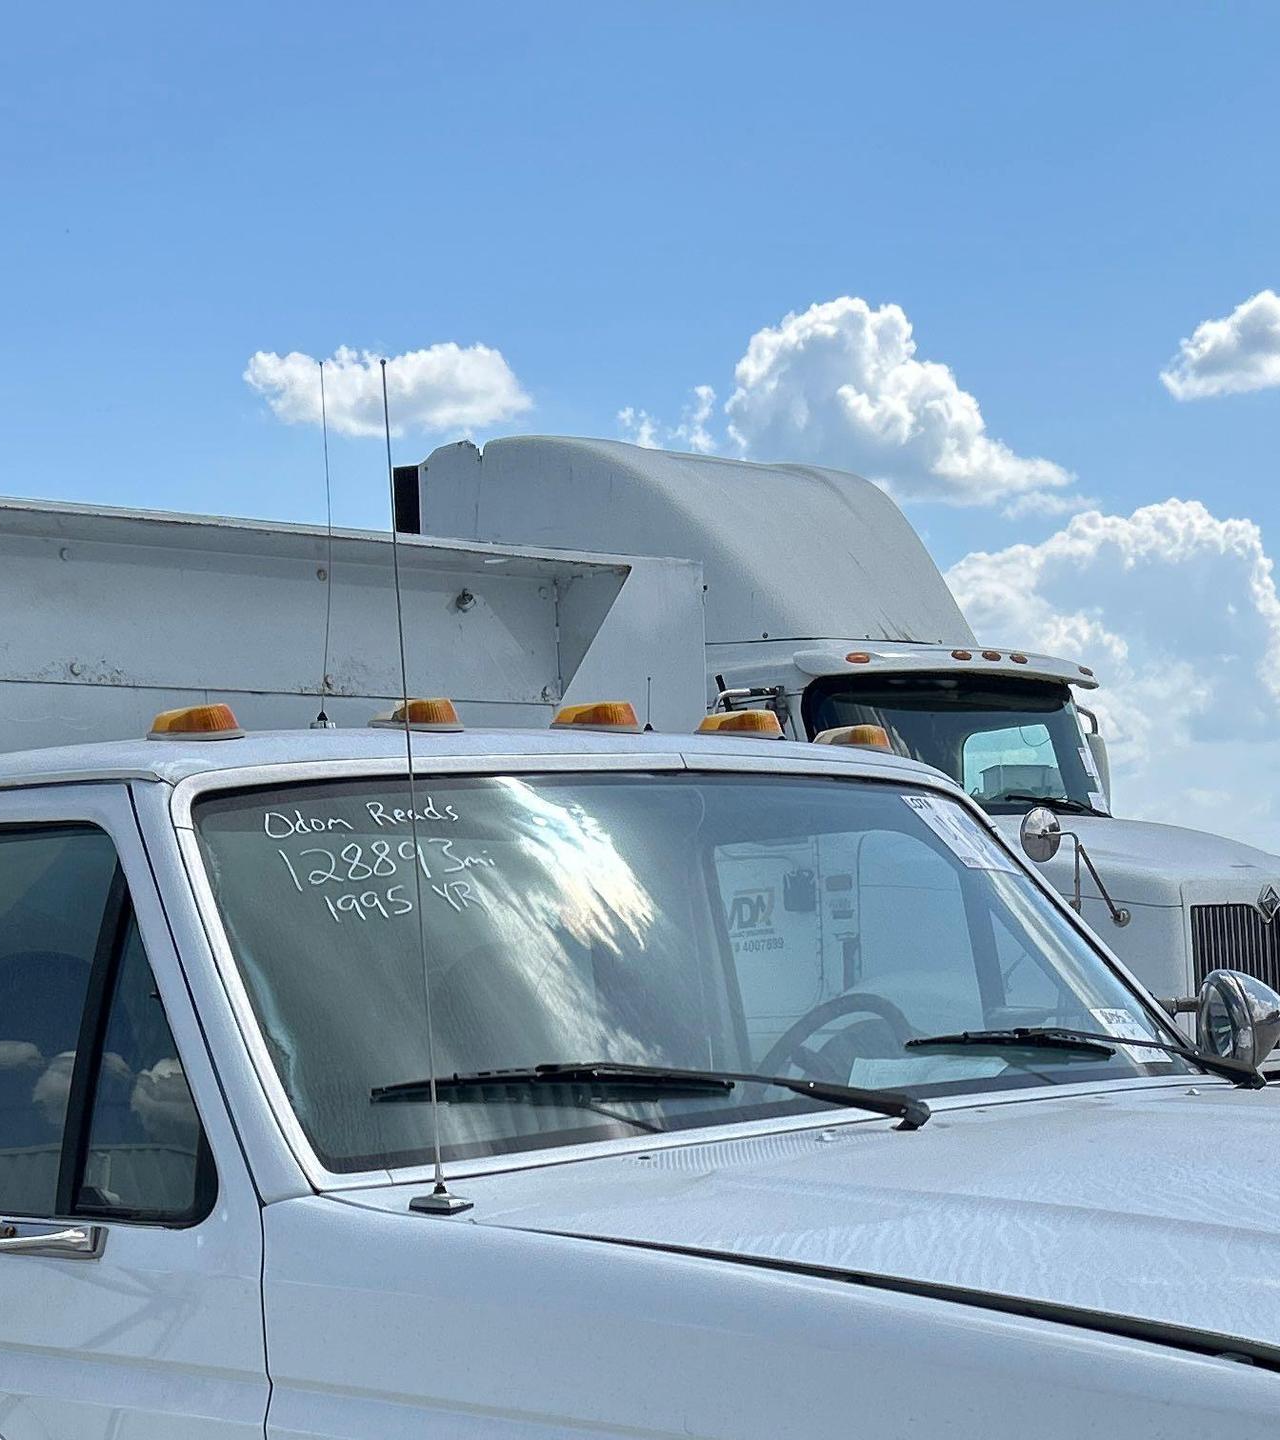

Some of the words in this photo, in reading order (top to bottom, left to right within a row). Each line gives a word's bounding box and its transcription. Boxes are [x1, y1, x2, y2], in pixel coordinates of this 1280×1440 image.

[264, 809, 354, 839] Odom
[366, 796, 459, 826] Reads
[323, 885, 413, 923] 1995
